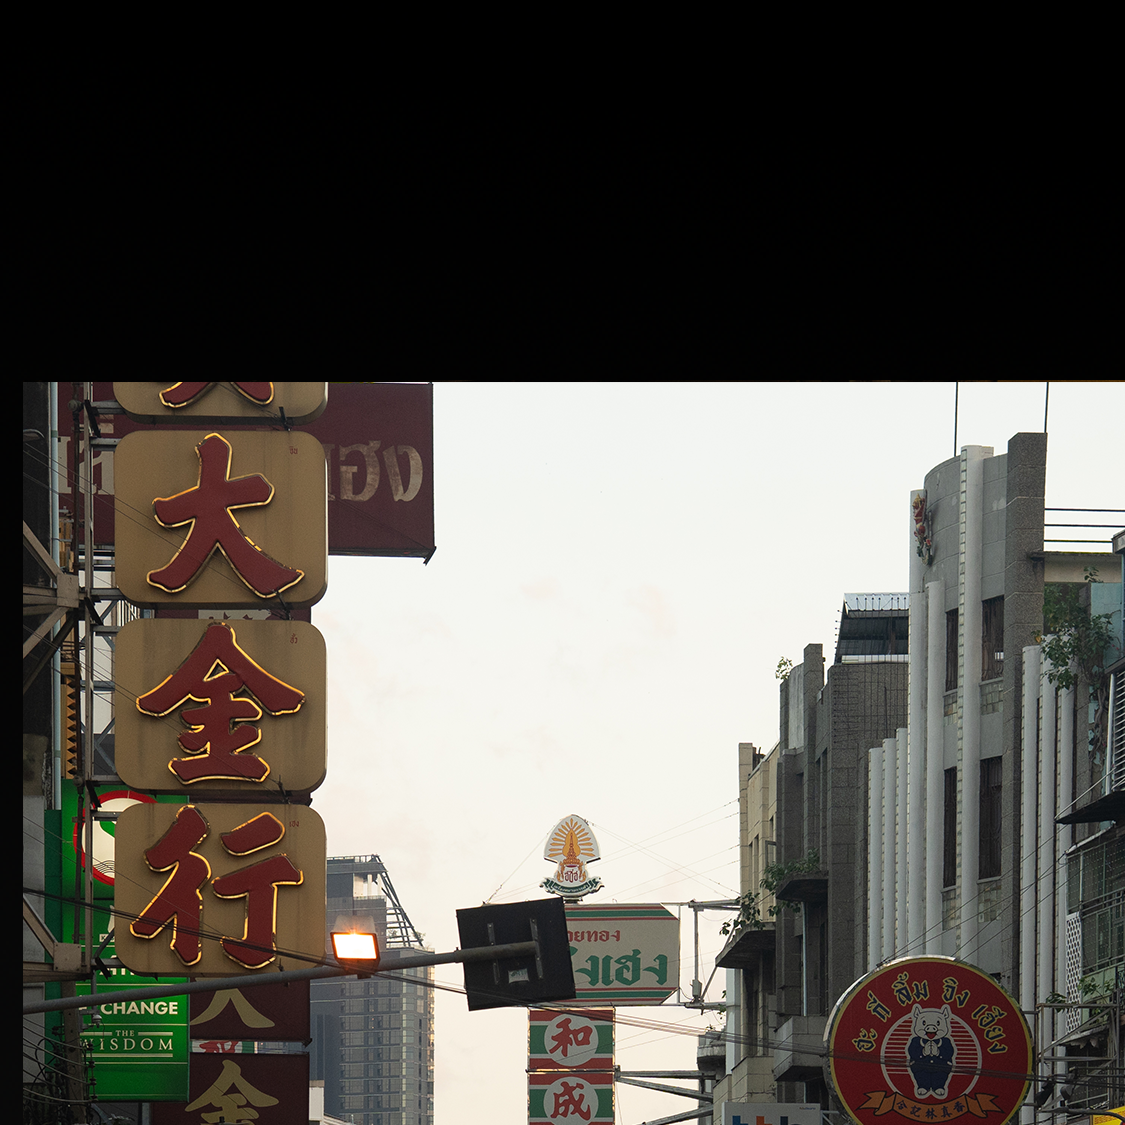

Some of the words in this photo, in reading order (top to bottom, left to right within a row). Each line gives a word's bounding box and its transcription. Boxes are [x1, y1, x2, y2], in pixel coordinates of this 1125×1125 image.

[130, 382, 306, 969] 大金行
[80, 1000, 178, 1015] CHANGE
[115, 1029, 135, 1037] THE
